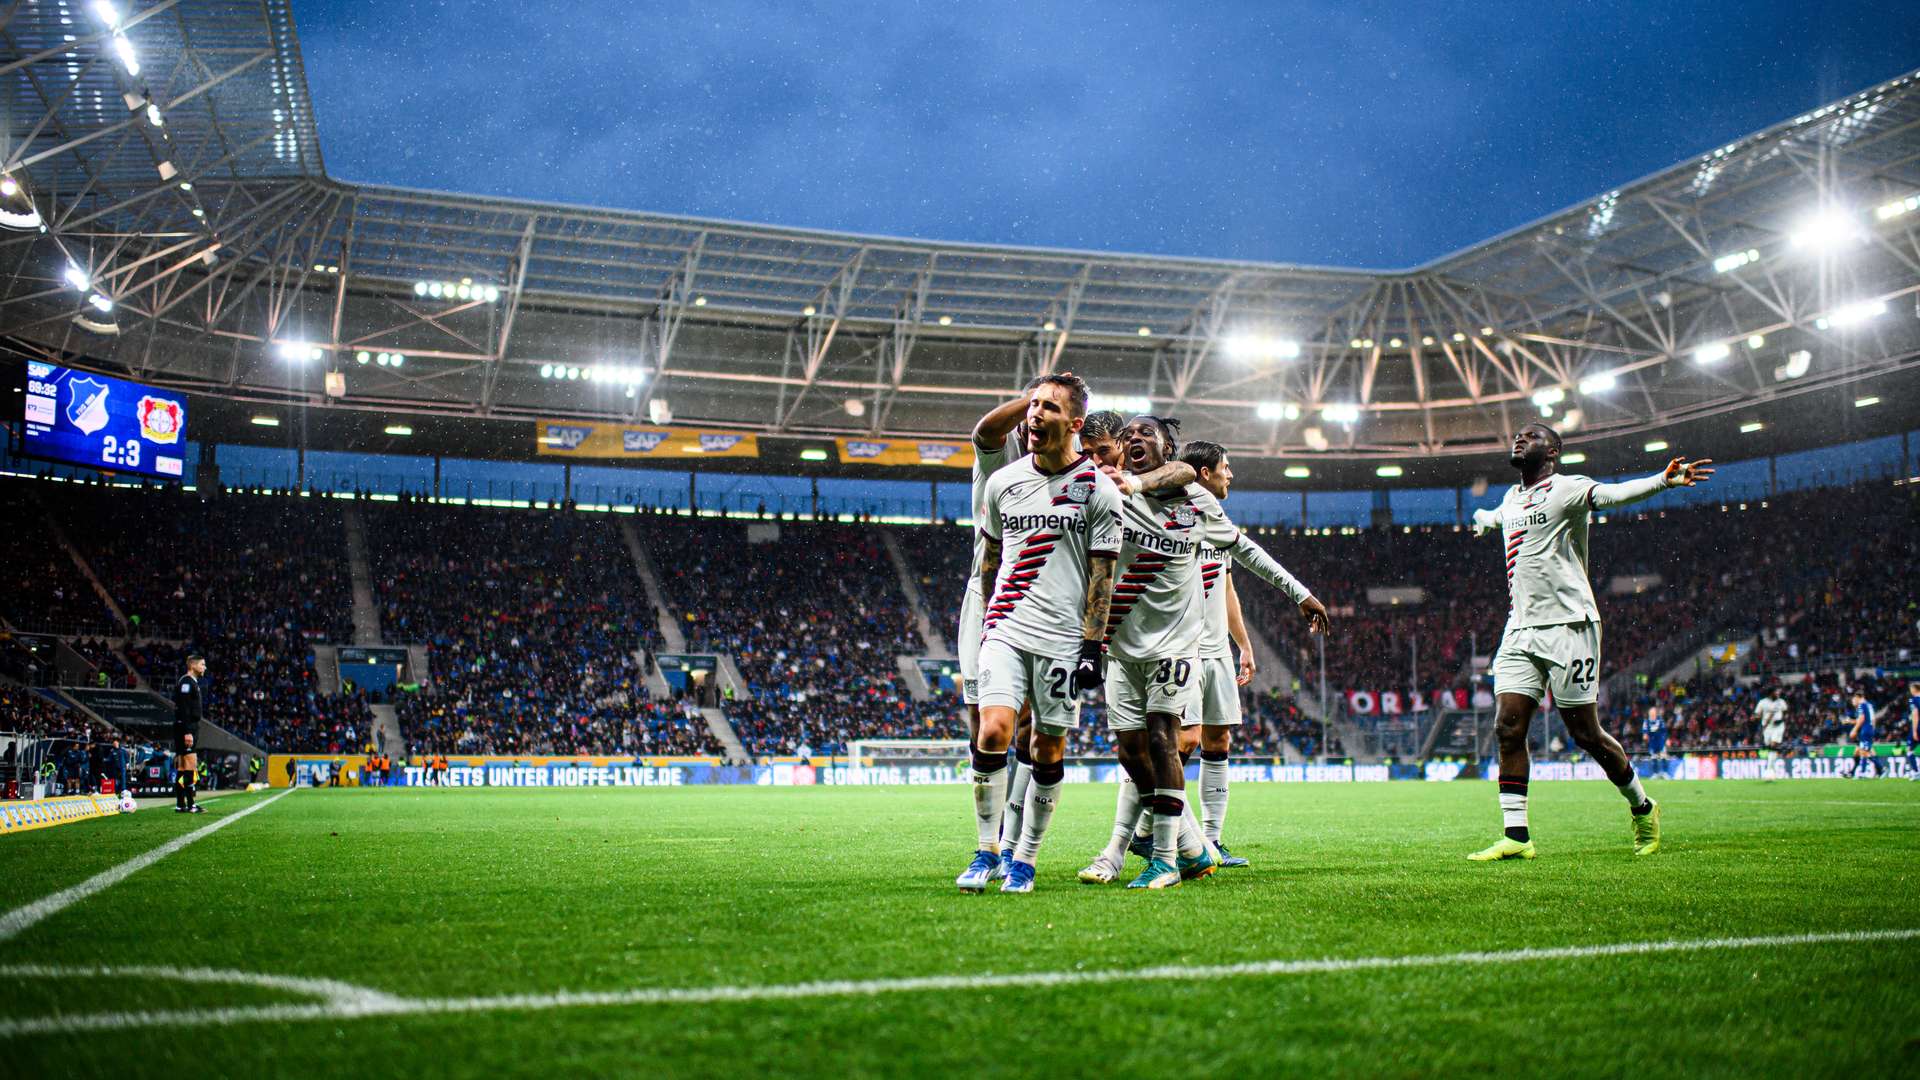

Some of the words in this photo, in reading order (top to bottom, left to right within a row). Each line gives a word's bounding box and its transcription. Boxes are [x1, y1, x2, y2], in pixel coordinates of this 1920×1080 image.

[102, 435, 141, 467] 2:3
[624, 433, 660, 450] SAP
[701, 436, 738, 450] SAP
[1000, 512, 1088, 534] Barmenia
[1102, 535, 1121, 545] triv
[1122, 525, 1196, 554] armenia
[1155, 657, 1191, 687] 30
[1572, 657, 1595, 683] 22
[1050, 667, 1078, 700] 20
[489, 767, 548, 786] UNTER
[553, 767, 682, 786] HOFFE-LIVE.DE
